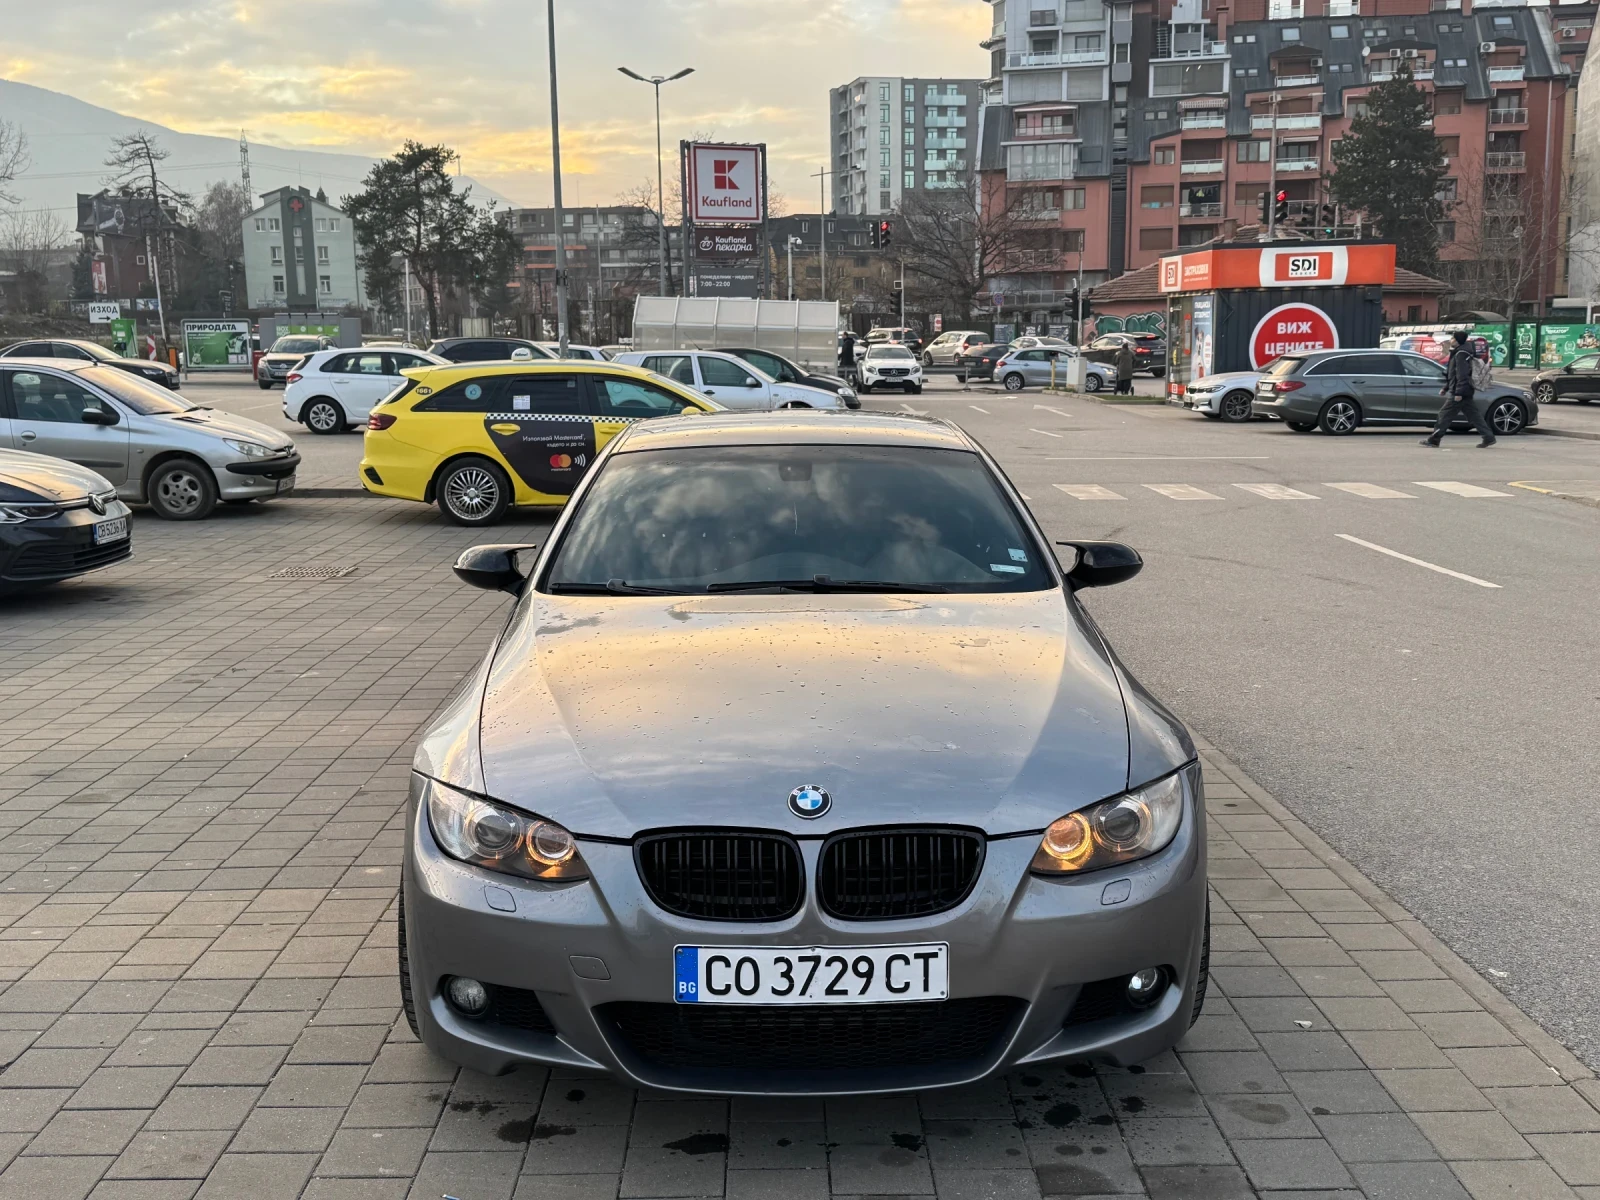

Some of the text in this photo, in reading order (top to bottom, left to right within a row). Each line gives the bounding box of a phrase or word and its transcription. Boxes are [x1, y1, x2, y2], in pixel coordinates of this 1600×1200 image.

[702, 196, 752, 208] Kaufland
[715, 243, 753, 253] пекарна
[1291, 258, 1316, 271] SDI
[91, 306, 118, 314] ИЗХОД
[186, 324, 237, 332] ПРИРОДАТА
[1277, 321, 1312, 334] ВИЖ
[792, 785, 826, 796] BMW
[705, 952, 939, 996] CO 3729 CT
[679, 982, 696, 994] BG
